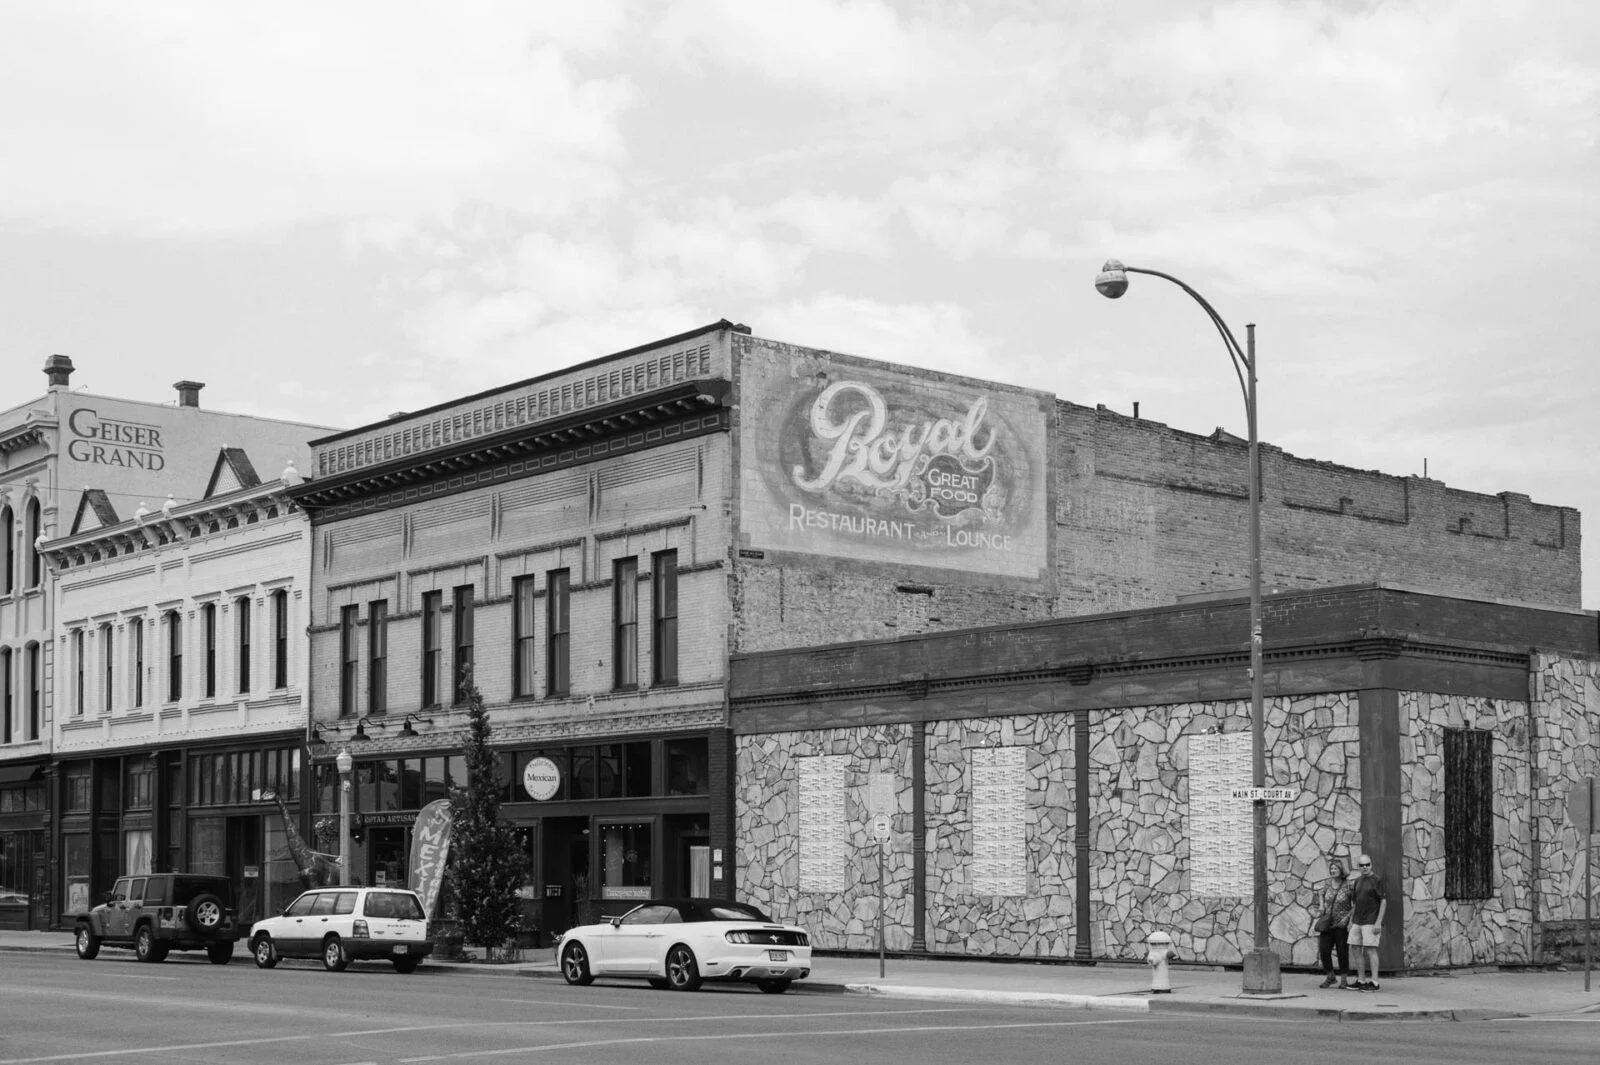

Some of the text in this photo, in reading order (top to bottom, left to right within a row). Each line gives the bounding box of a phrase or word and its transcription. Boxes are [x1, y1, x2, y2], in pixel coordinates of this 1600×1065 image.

[68, 408, 164, 449] GEISER
[793, 380, 996, 490] Royal
[68, 439, 165, 471] GRAND
[928, 468, 979, 490] GREAT
[930, 487, 978, 503] FOOD
[789, 503, 917, 540] RESTAURANT
[947, 524, 1012, 551] LOUNGE
[526, 772, 557, 782] Mexican
[1232, 790, 1249, 799] MAIN
[1263, 790, 1283, 799] COURT
